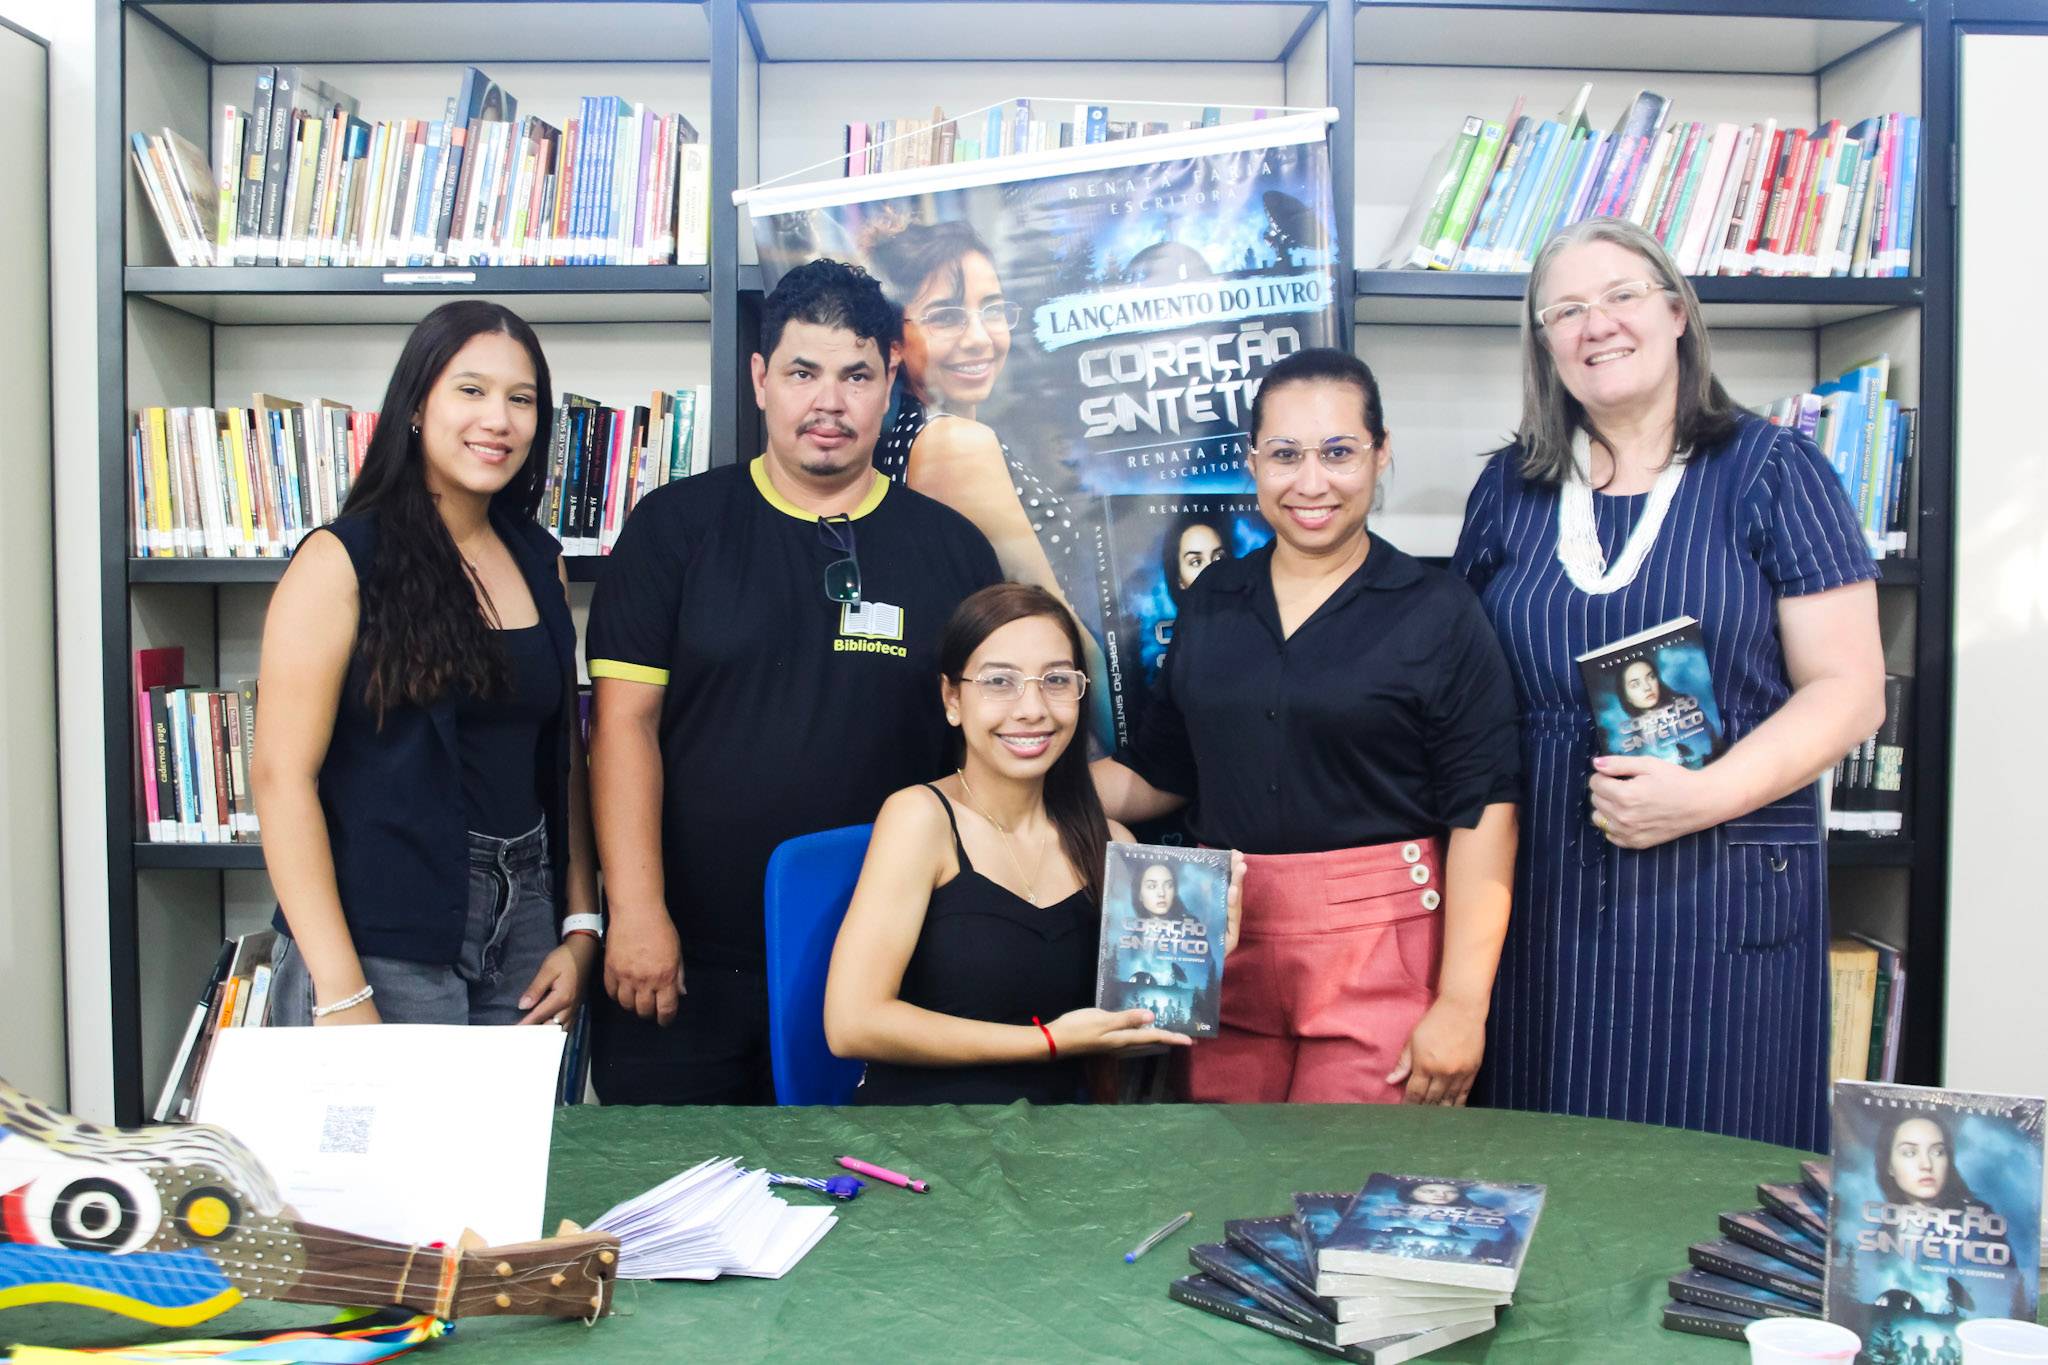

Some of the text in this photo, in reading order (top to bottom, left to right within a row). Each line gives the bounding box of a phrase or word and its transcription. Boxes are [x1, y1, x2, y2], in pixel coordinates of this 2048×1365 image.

[1068, 161, 1273, 201] RENATA FARIA
[1111, 189, 1237, 216] ESCRITORA
[1050, 280, 1321, 334] LANÇAMENTO DO LIVRO
[1078, 321, 1302, 389] CORAÇÃO
[1079, 376, 1262, 439] SINTÉTI
[1868, 377, 1880, 419] Sistemas
[1128, 446, 1206, 468] RENATA
[1160, 459, 1249, 480] ESCRITORA
[1861, 423, 1875, 480] Operacionais
[1150, 502, 1261, 514] RENATA FARIA
[1095, 525, 1112, 617] RENATA FARIA
[833, 639, 908, 658] Biblioteca
[244, 704, 254, 753] MITOLOGIA
[1115, 695, 1129, 747] SINTÉTIC
[157, 722, 168, 784] cadernos pagu
[1119, 935, 1209, 955] SINTÉTICO
[1122, 917, 1207, 938] CORAÇÃO
[1865, 1098, 1937, 1112] RENATA
[1861, 1202, 2009, 1239] CORAÇÃO
[1856, 1229, 2011, 1266] SINTÉTICO
